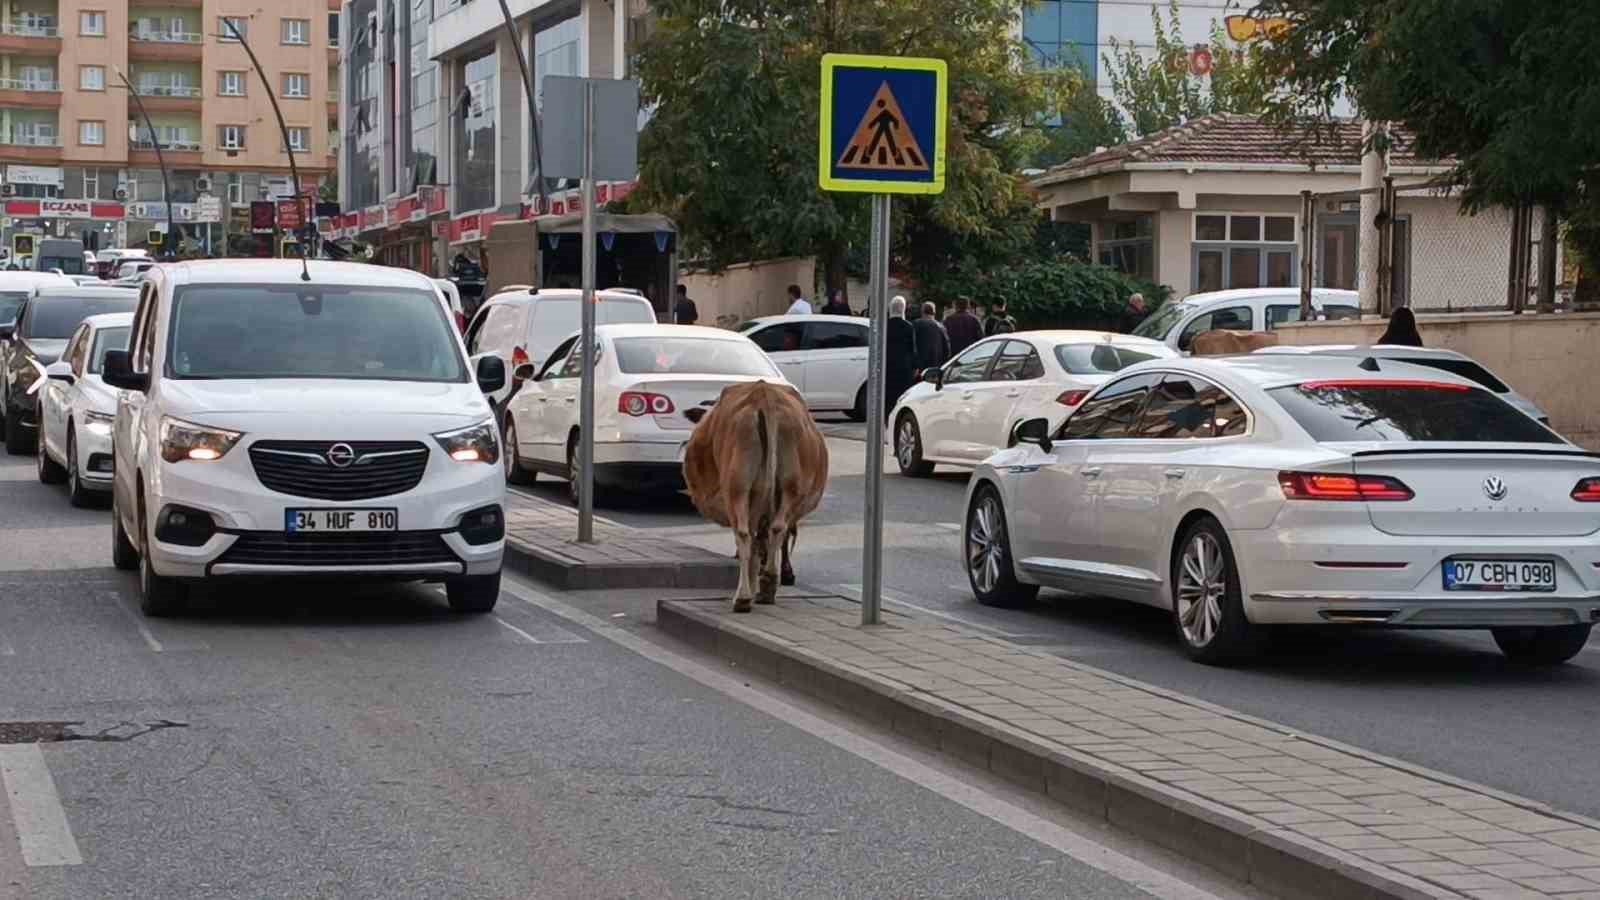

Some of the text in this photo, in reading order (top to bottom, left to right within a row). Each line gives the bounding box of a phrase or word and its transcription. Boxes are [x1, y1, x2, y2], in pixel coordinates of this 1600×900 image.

[42, 202, 89, 212] ECZANE
[297, 512, 394, 529] 34 HUF 810
[1455, 563, 1474, 582] 07
[1481, 564, 1517, 583] CBH
[1522, 564, 1552, 583] 098
